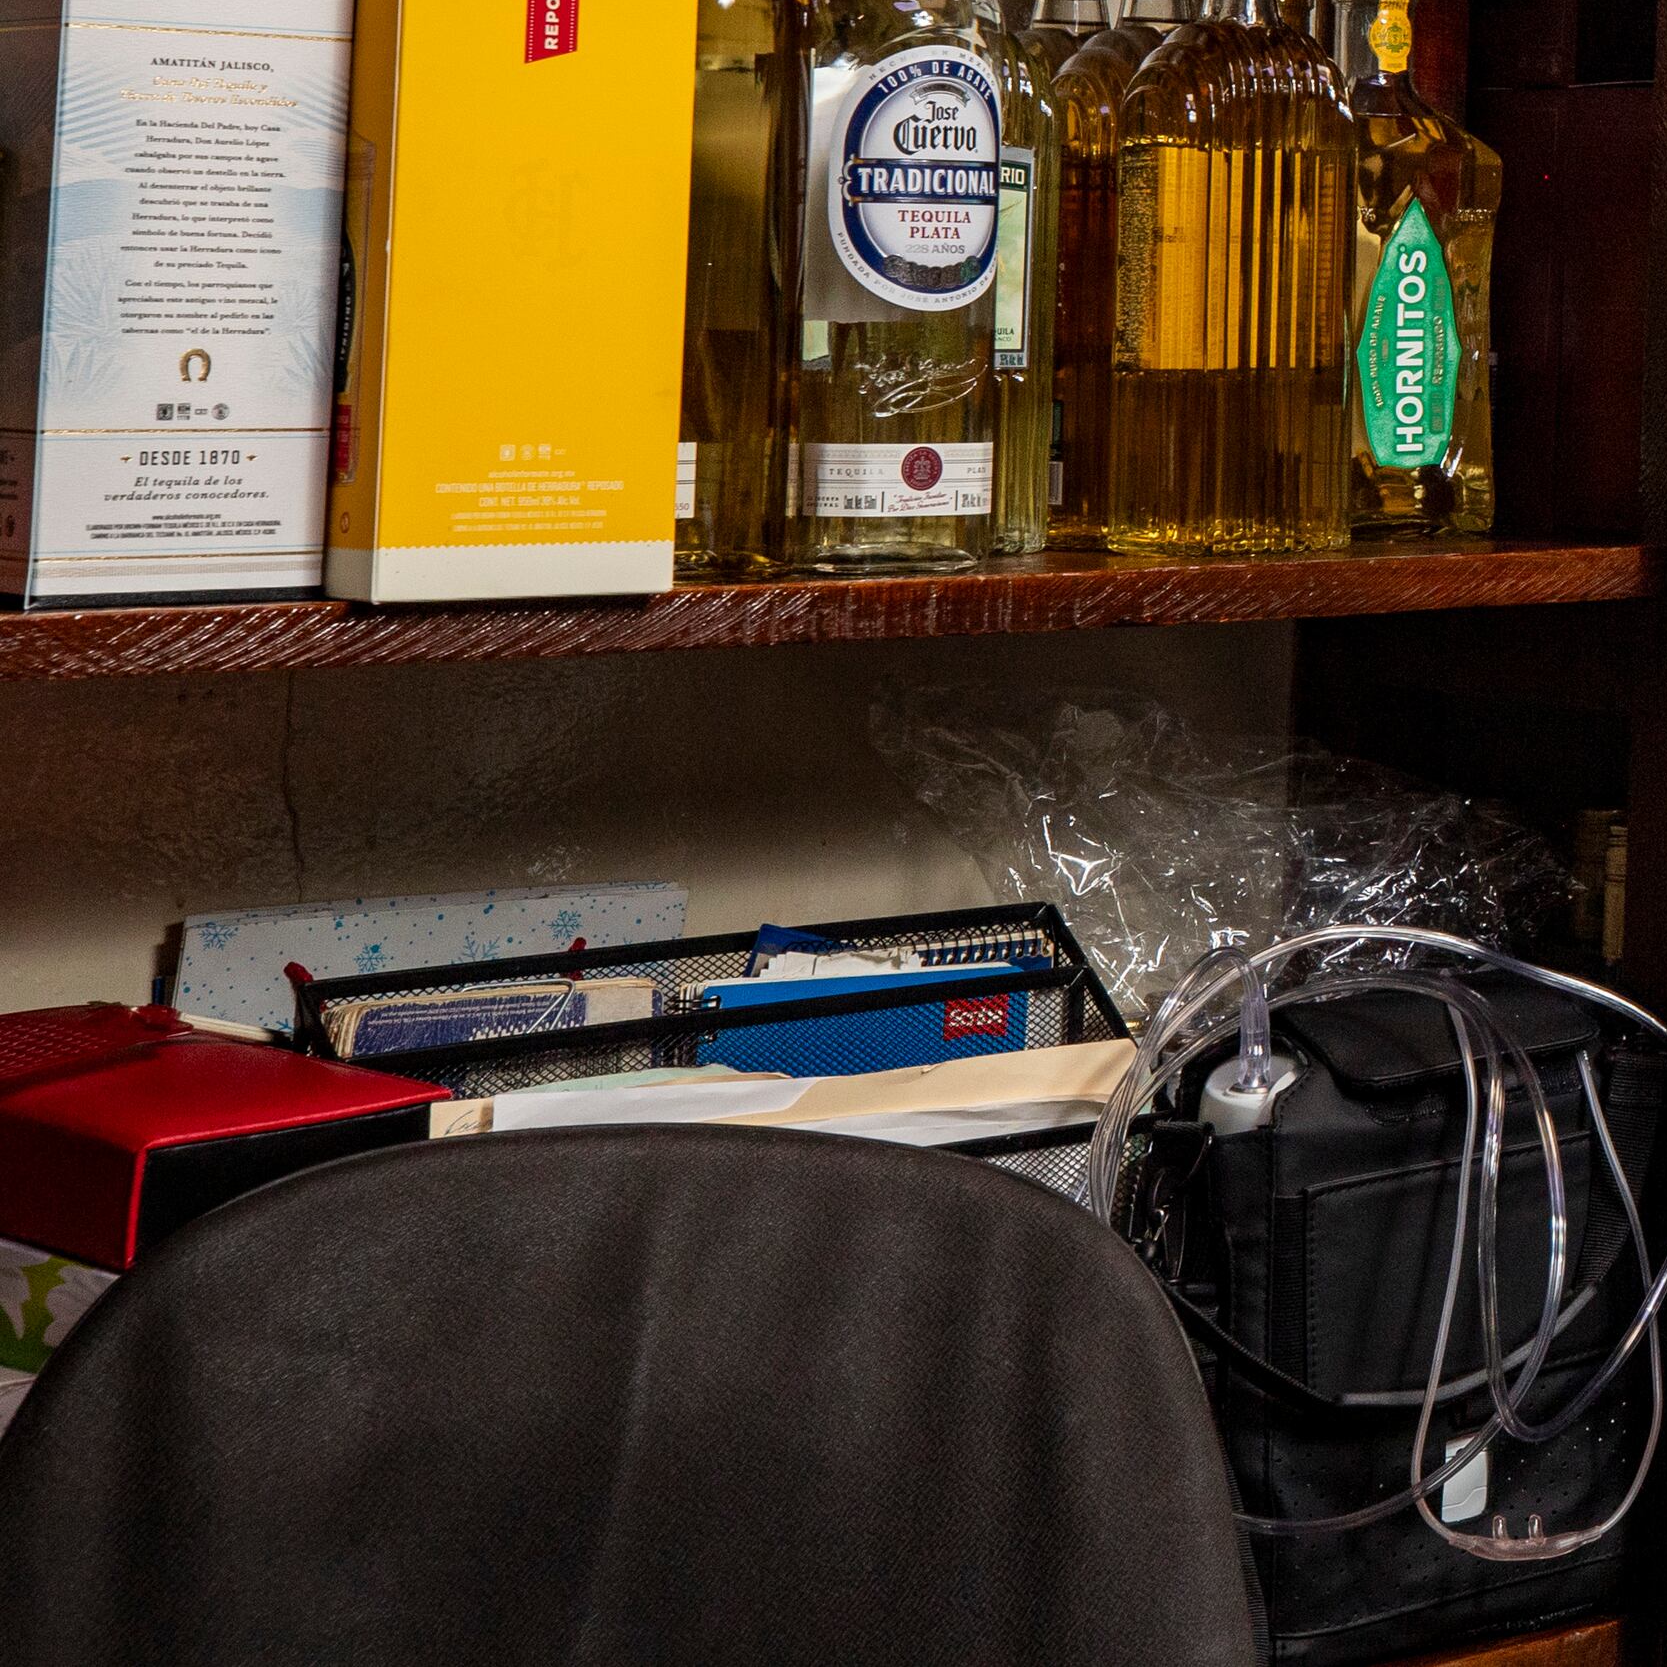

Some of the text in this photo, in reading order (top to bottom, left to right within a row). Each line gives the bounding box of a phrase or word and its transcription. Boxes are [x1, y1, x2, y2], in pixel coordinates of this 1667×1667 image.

[151, 56, 274, 73] AMATITÁN JALISCO,
[878, 61, 992, 100] 100% DE AGAVE
[926, 100, 959, 124] Jose
[159, 119, 199, 129] Hacienda
[201, 121, 215, 130] Del
[893, 114, 977, 155] Cuervo
[858, 167, 996, 197] TRADICIONAL
[898, 209, 971, 223] TEQUILA
[910, 226, 961, 240] PLATA
[931, 241, 965, 254] AÑOS
[837, 232, 978, 304] FUNDADA ANTONIO
[1396, 250, 1427, 452] HORNITOS
[140, 450, 240, 465] DESDE 1870
[134, 475, 242, 488] El tequila de los
[104, 489, 269, 501] verdaderos conocedores.
